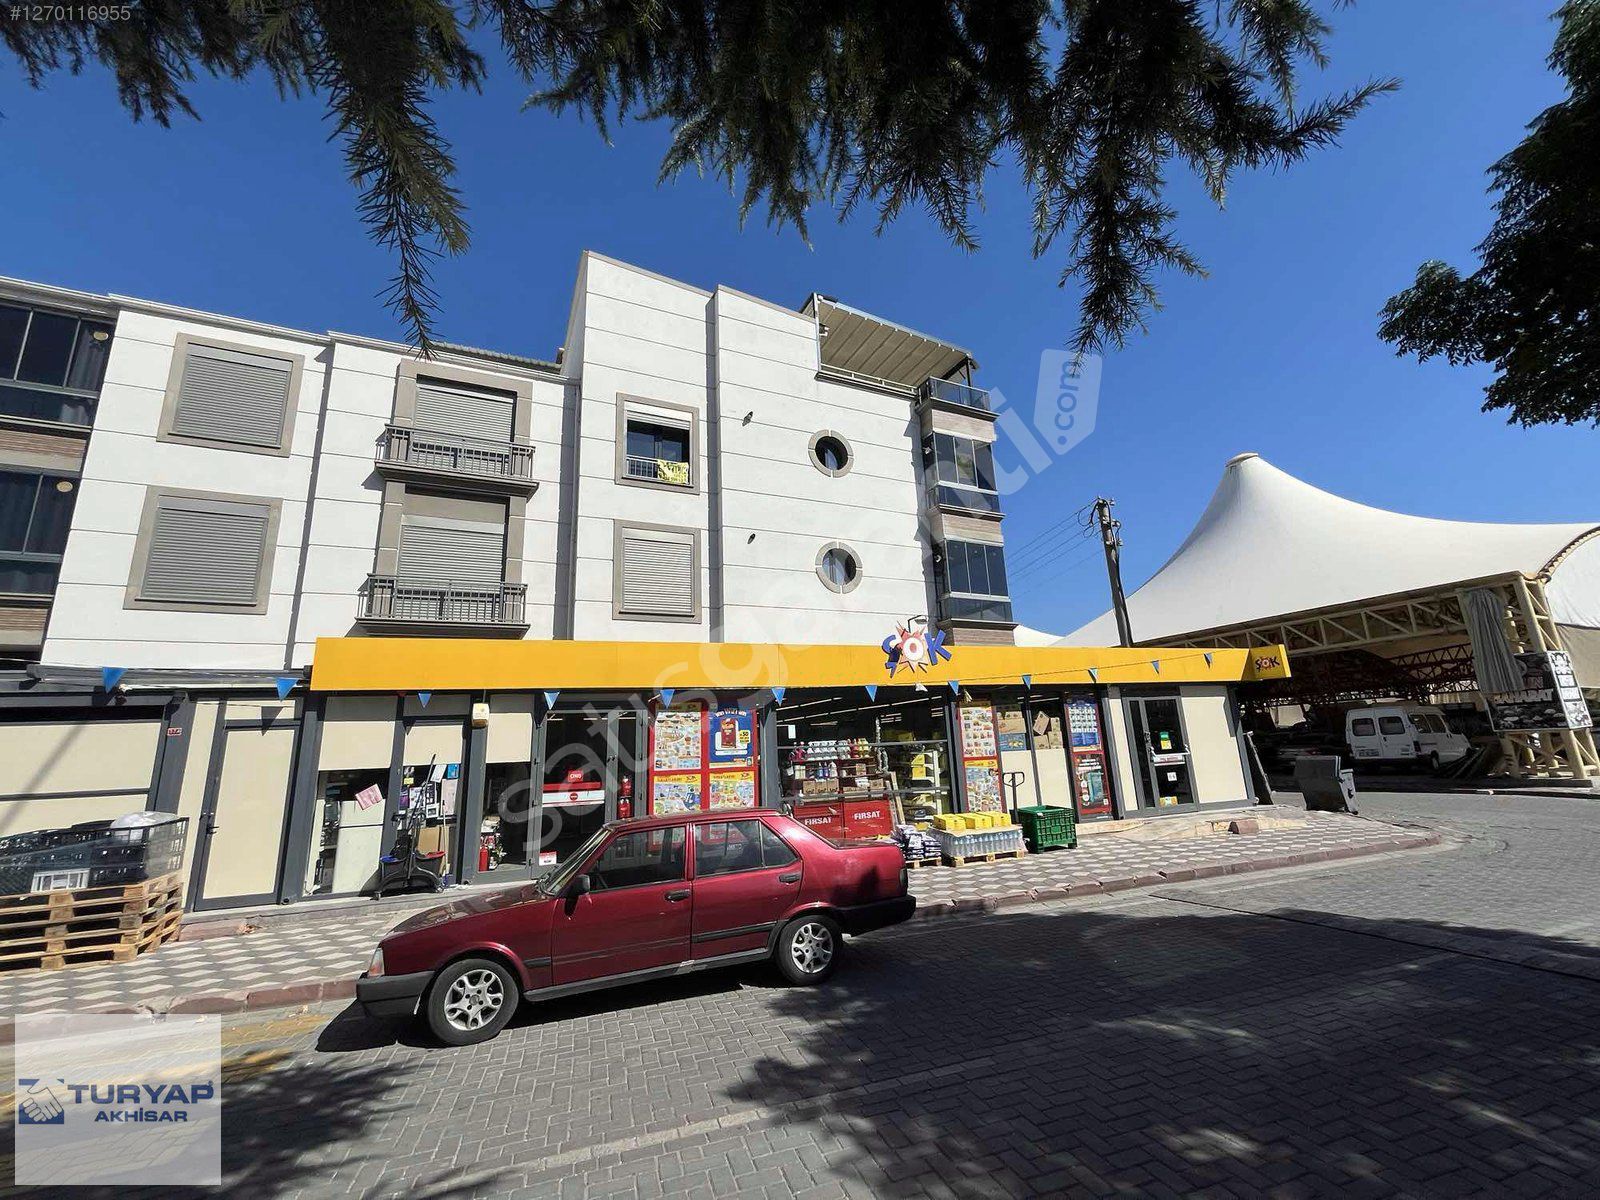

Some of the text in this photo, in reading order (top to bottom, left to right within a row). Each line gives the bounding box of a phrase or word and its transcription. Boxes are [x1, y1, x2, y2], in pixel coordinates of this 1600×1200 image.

[881, 629, 952, 678] ŞOK
[853, 811, 881, 820] FIRSAT
[804, 817, 832, 825] FIRSAT
